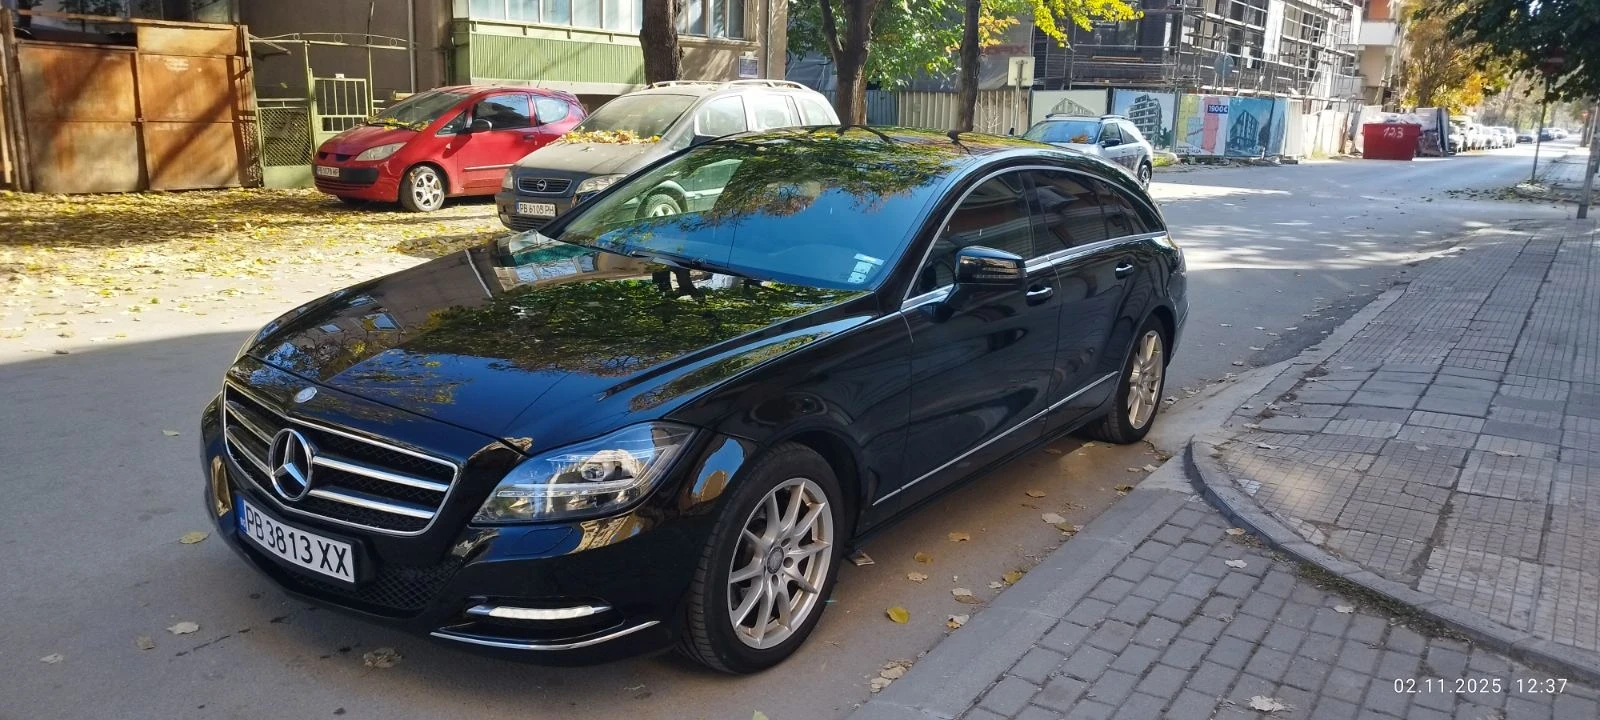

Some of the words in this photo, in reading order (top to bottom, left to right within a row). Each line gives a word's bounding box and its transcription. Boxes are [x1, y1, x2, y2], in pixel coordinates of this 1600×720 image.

[1383, 127, 1404, 138] 123
[245, 504, 265, 541] PB
[266, 520, 313, 564] 3813
[317, 539, 349, 577] XX
